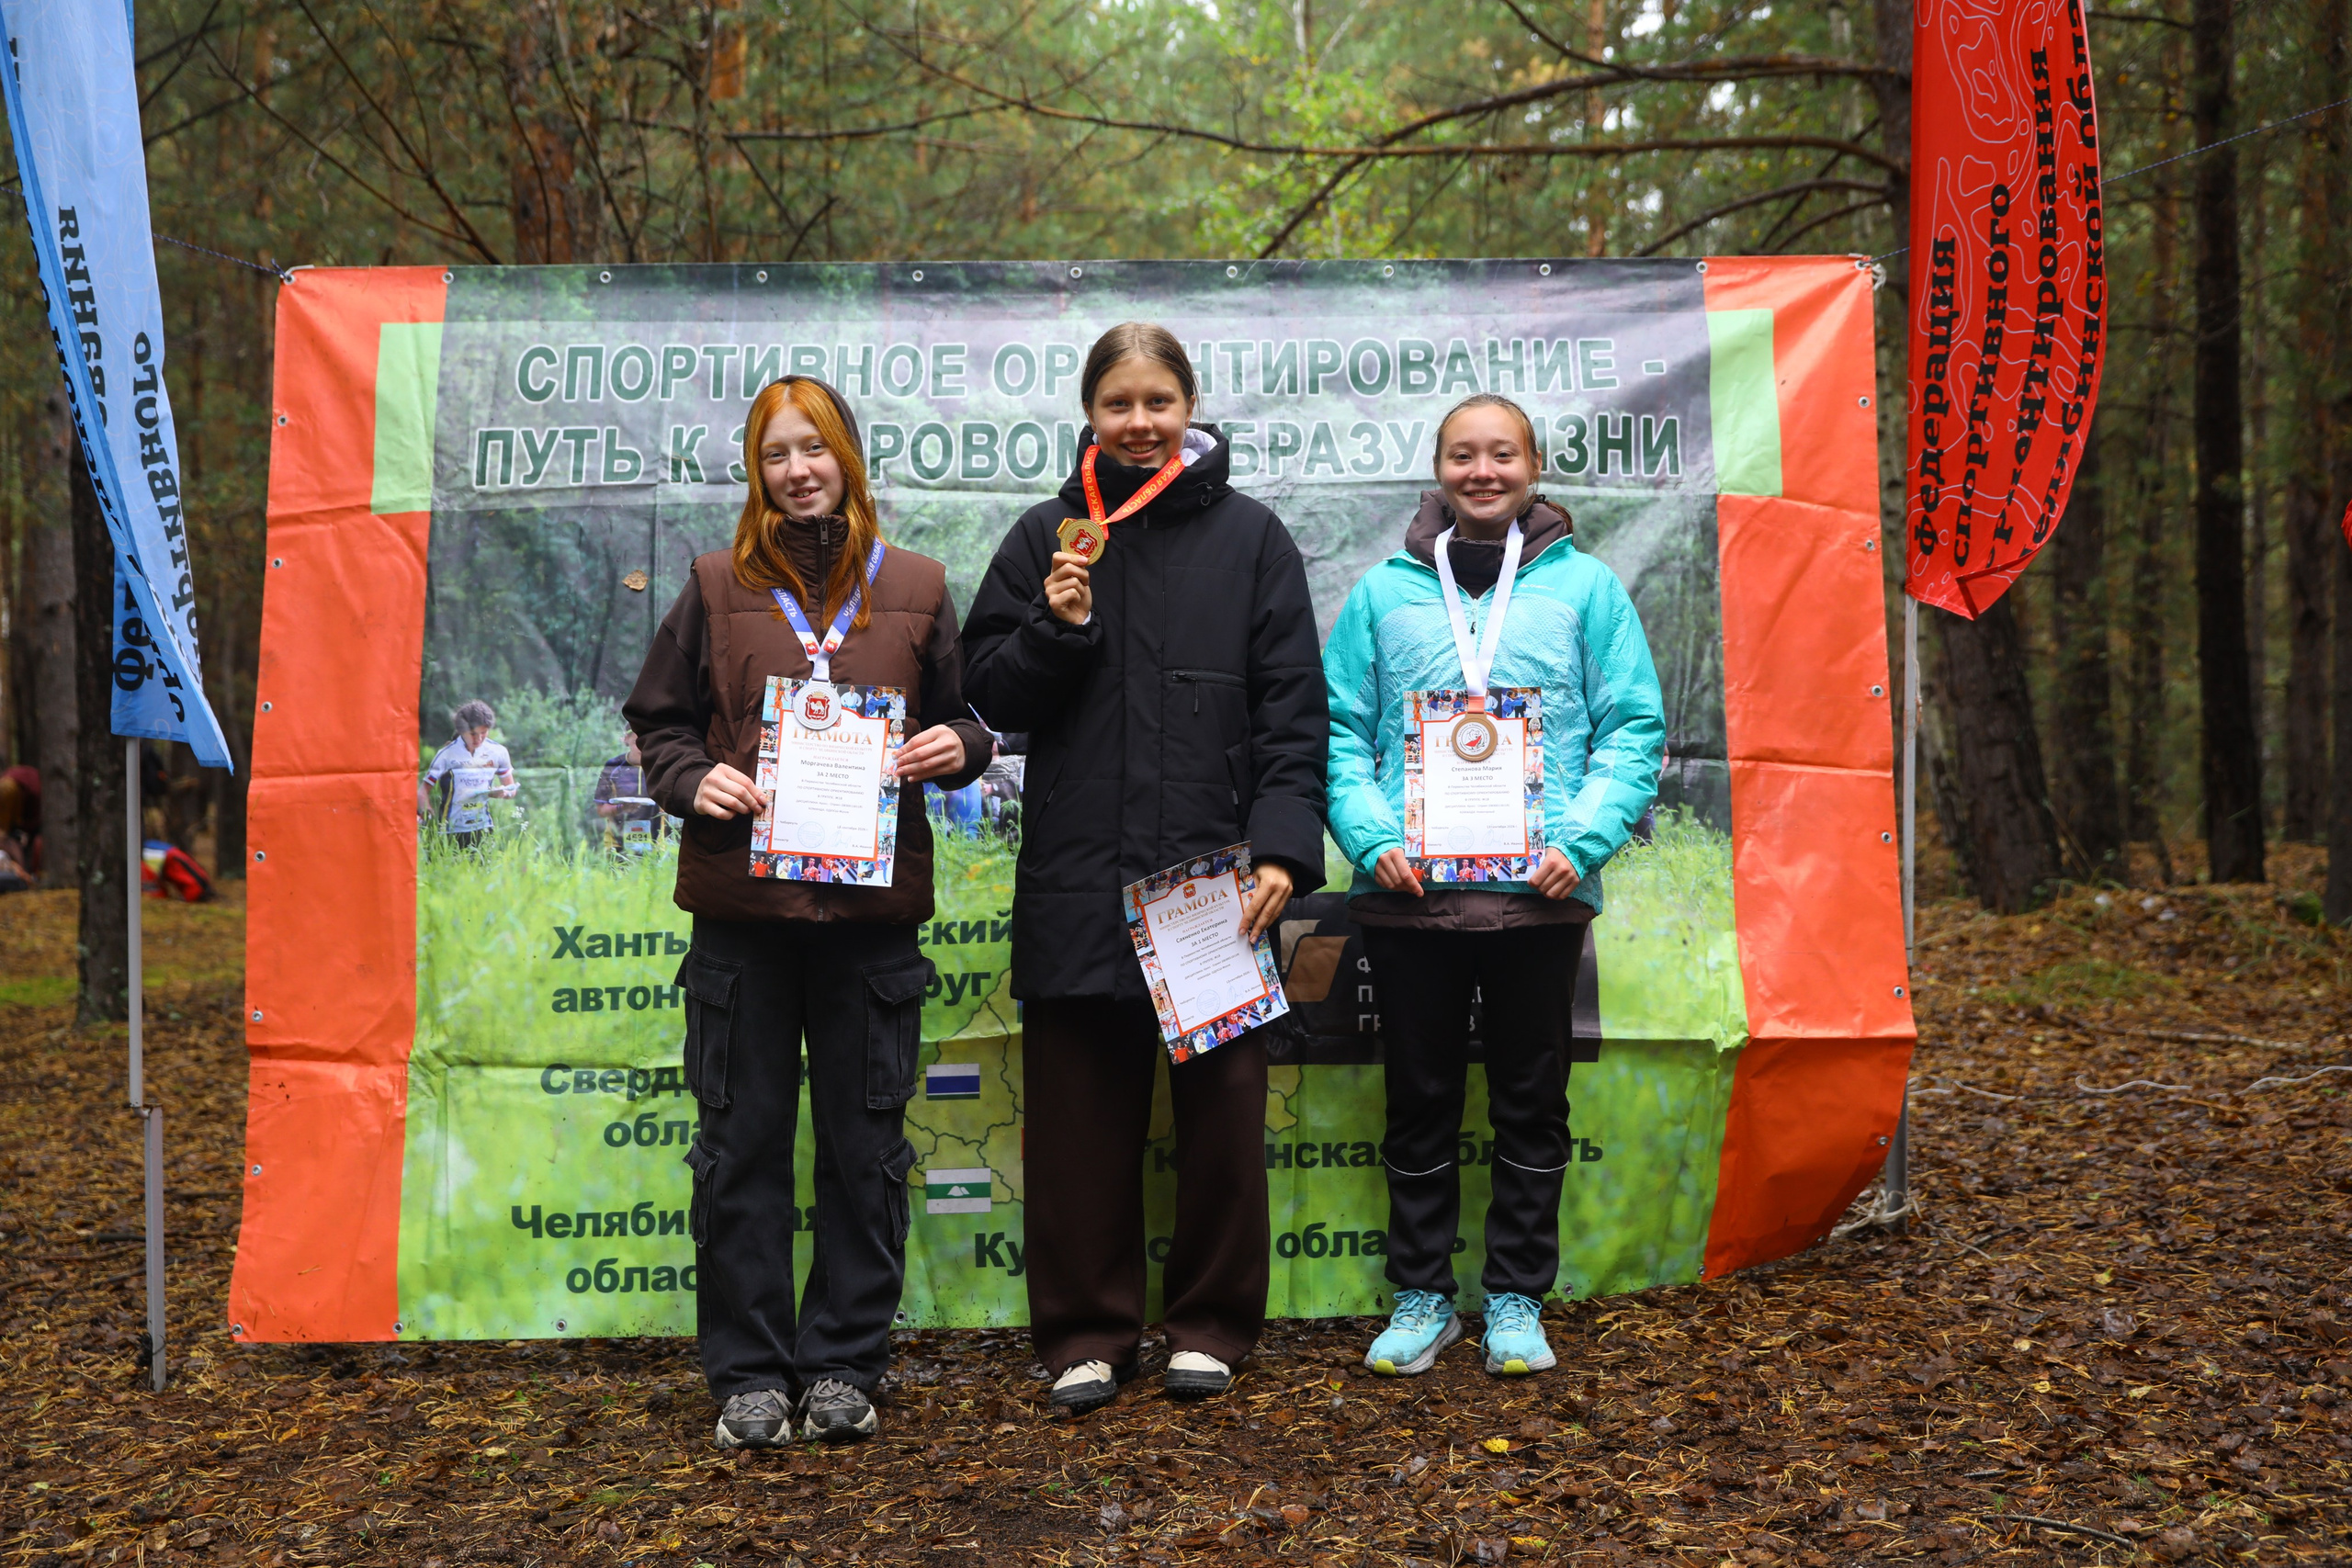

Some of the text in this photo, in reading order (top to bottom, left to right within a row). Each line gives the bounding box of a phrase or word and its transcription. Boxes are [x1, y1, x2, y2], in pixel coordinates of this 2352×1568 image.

[516, 343, 967, 403] СПОРТИВНОЕ
[992, 337, 1619, 398] ОРНТИРОВАНИЕ
[1954, 184, 2010, 567] спортивного
[1915, 237, 1960, 556] Федерация
[473, 426, 644, 487] ПУТЬ
[669, 424, 707, 485] К
[1220, 420, 1426, 478] БРАЗУ
[1085, 446, 1097, 483] ОБЛАСТЬ
[1122, 483, 1158, 513] ОБЛАСТЬ
[775, 587, 797, 618] БЛАСТЬ
[794, 728, 871, 744] ГРАМОТА
[1159, 890, 1227, 924] ГРАМОТА
[1176, 919, 1227, 943] Сахненко Екатерина
[1202, 931, 1218, 942] МЕСТО
[920, 972, 990, 1008] руг
[566, 1258, 696, 1294] облас
